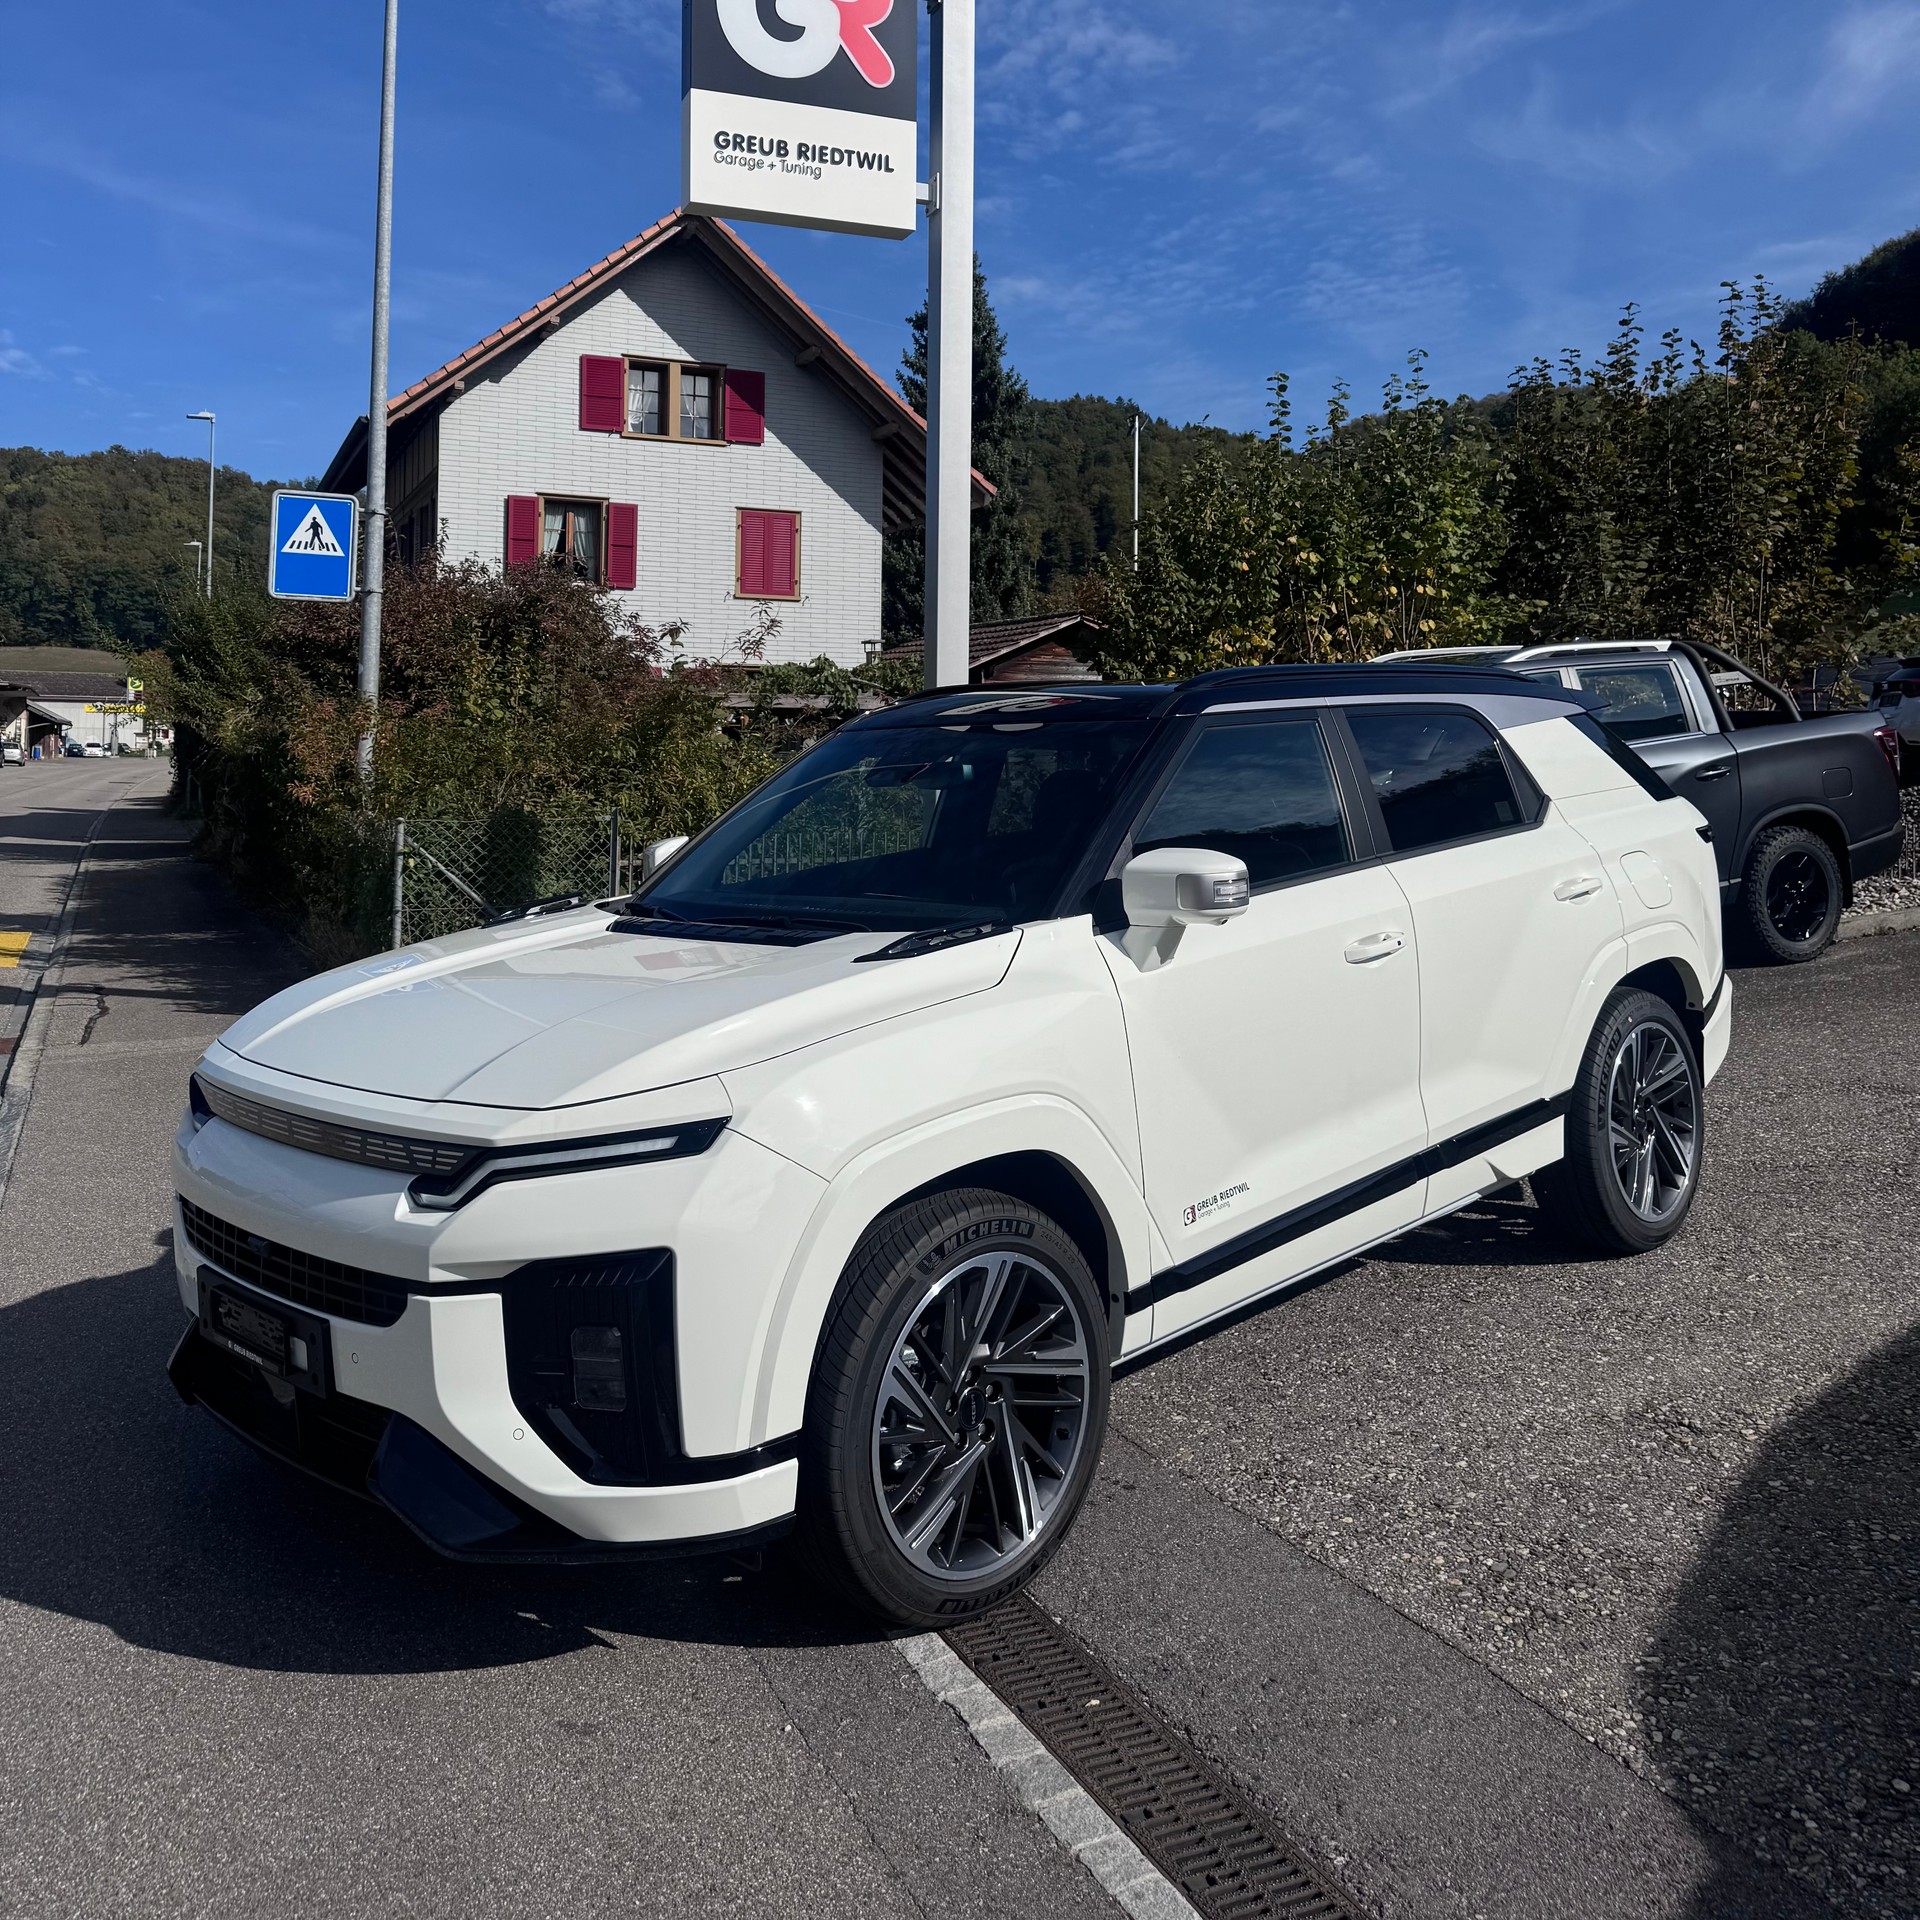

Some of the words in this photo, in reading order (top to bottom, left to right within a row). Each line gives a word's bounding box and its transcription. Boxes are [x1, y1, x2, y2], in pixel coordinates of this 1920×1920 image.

[713, 130, 790, 159] GREUB
[796, 142, 895, 174] RIEDTWIL
[713, 151, 765, 172] Garage
[767, 162, 777, 172] +
[779, 159, 822, 180] Tuning
[1600, 1031, 1621, 1108] MICHELIN
[1197, 1195, 1218, 1212] GREUB
[1219, 1182, 1250, 1202] RIEDTWIL
[943, 1218, 1030, 1255] MICHELIN
[1040, 1230, 1063, 1250] 245/45
